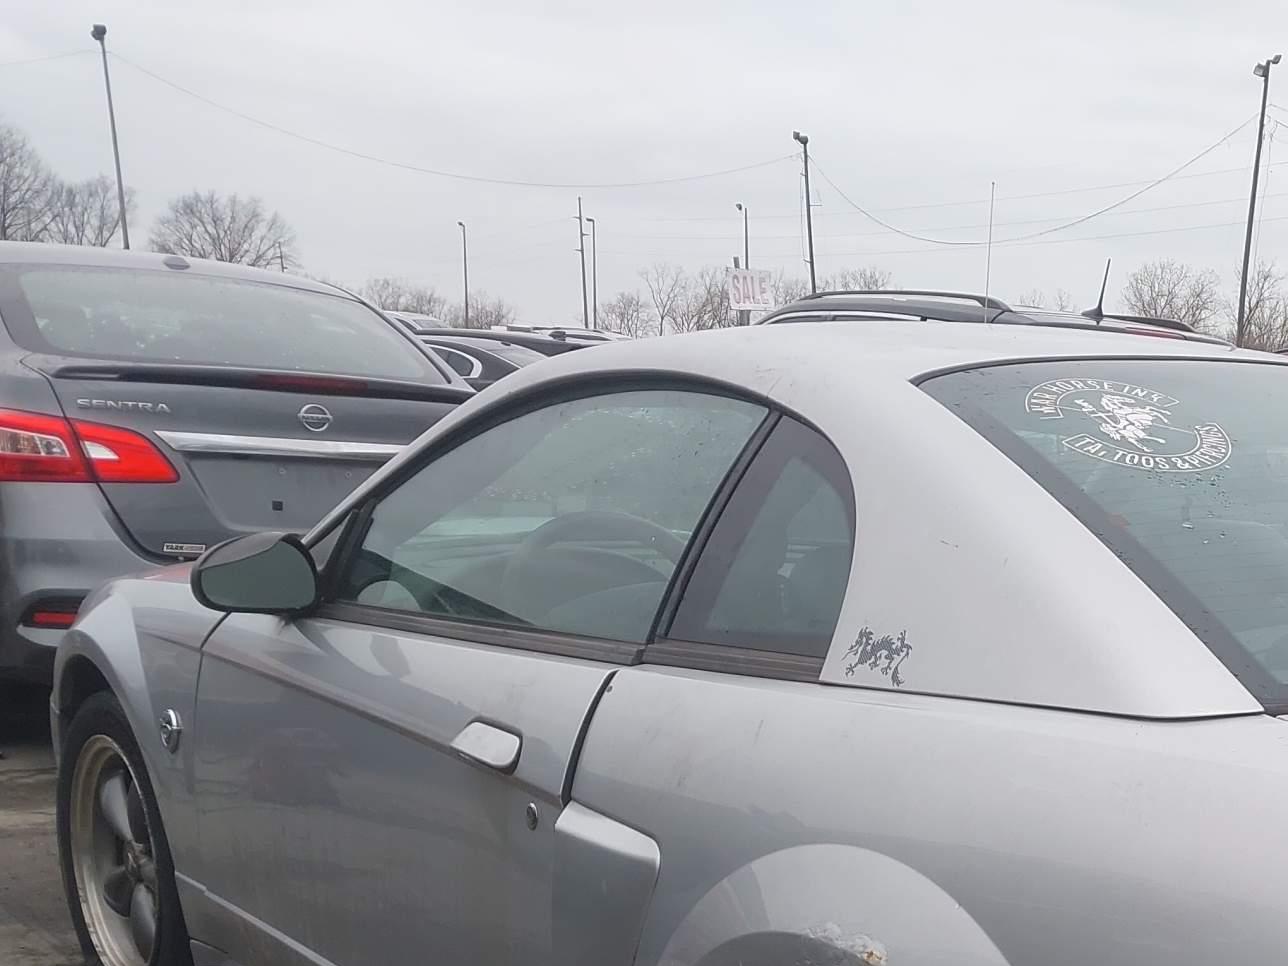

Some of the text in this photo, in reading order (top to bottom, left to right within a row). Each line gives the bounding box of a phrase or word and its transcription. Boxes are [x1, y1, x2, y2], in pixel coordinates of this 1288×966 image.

[731, 273, 769, 305] SALE
[1041, 379, 1114, 394] HORSE
[76, 398, 172, 414] SENTRA
